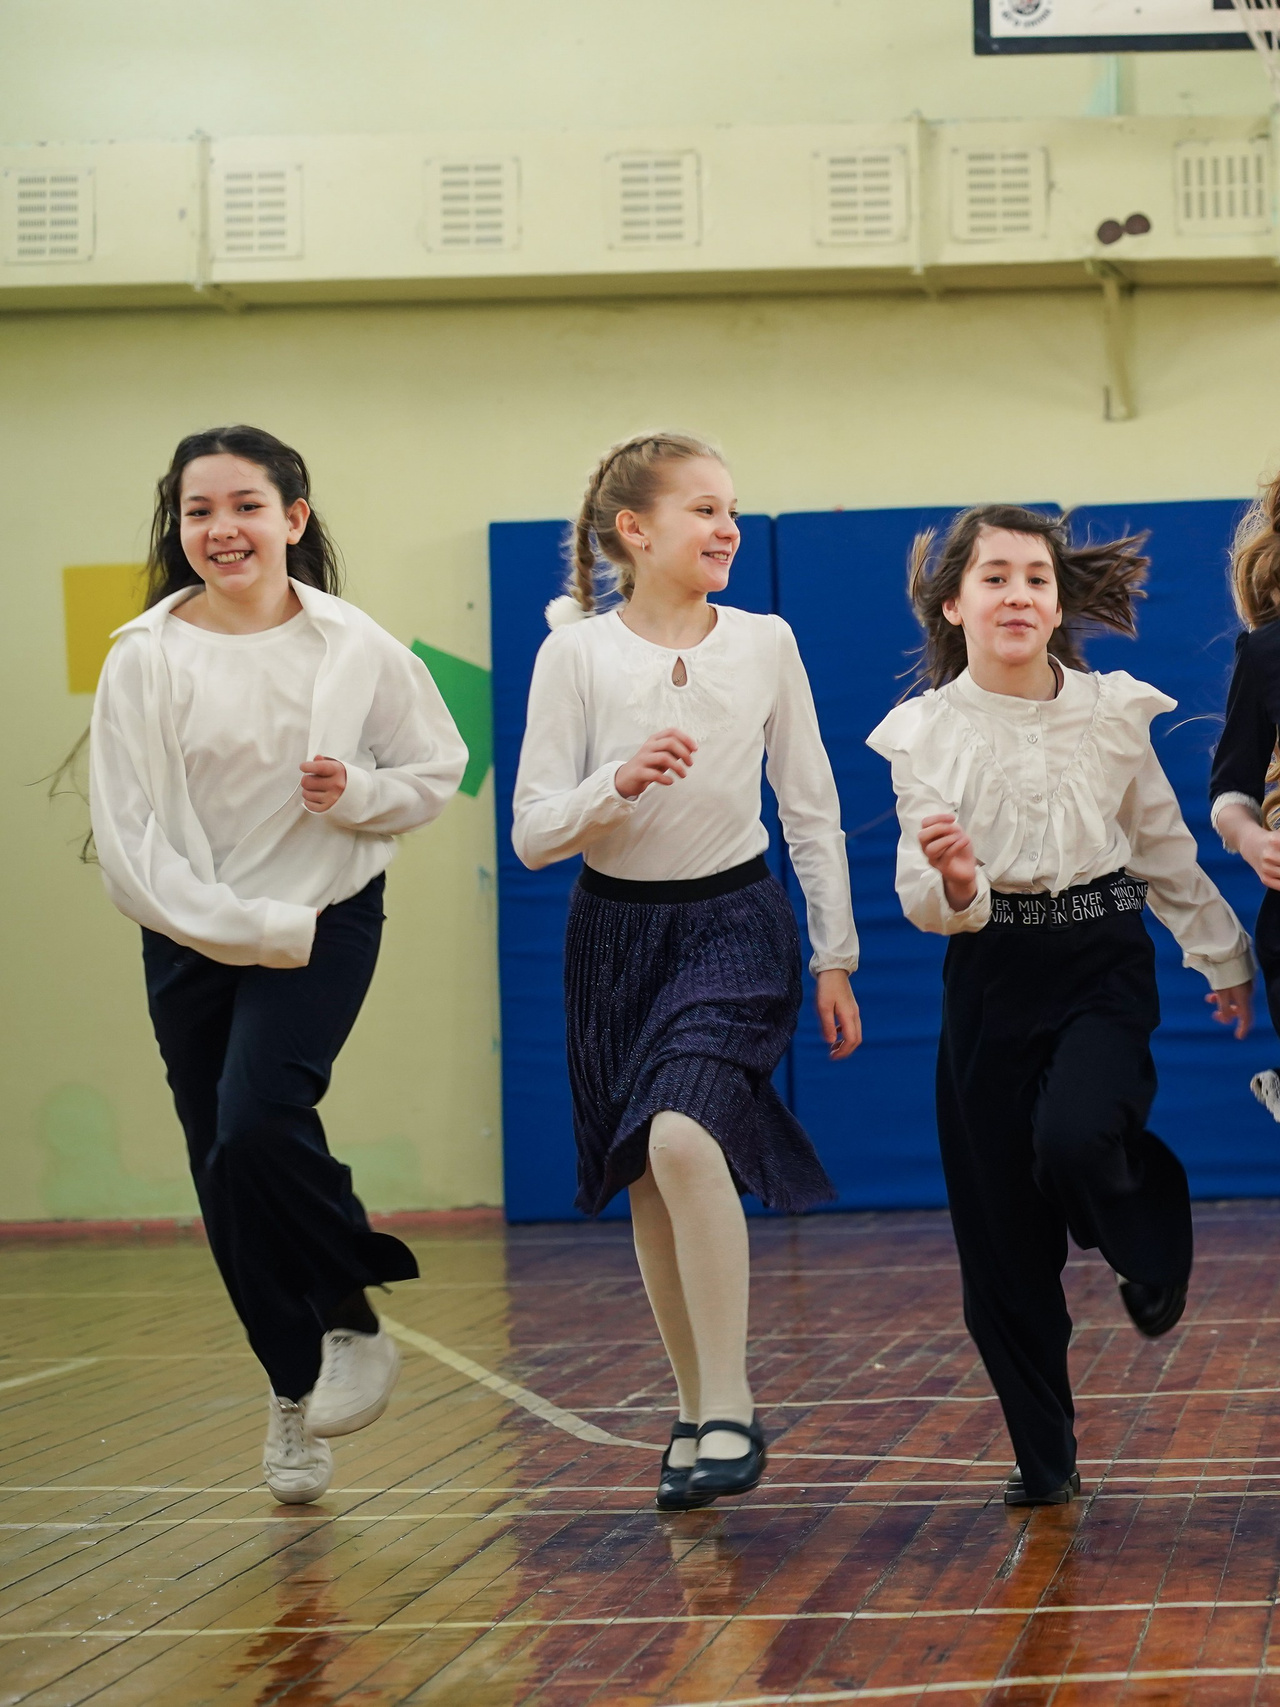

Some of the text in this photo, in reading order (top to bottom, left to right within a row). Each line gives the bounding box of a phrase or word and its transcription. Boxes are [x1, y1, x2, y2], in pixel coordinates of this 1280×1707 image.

[1109, 885, 1135, 898] MIND
[991, 911, 1014, 924] MIN
[1071, 904, 1108, 921] MIND
